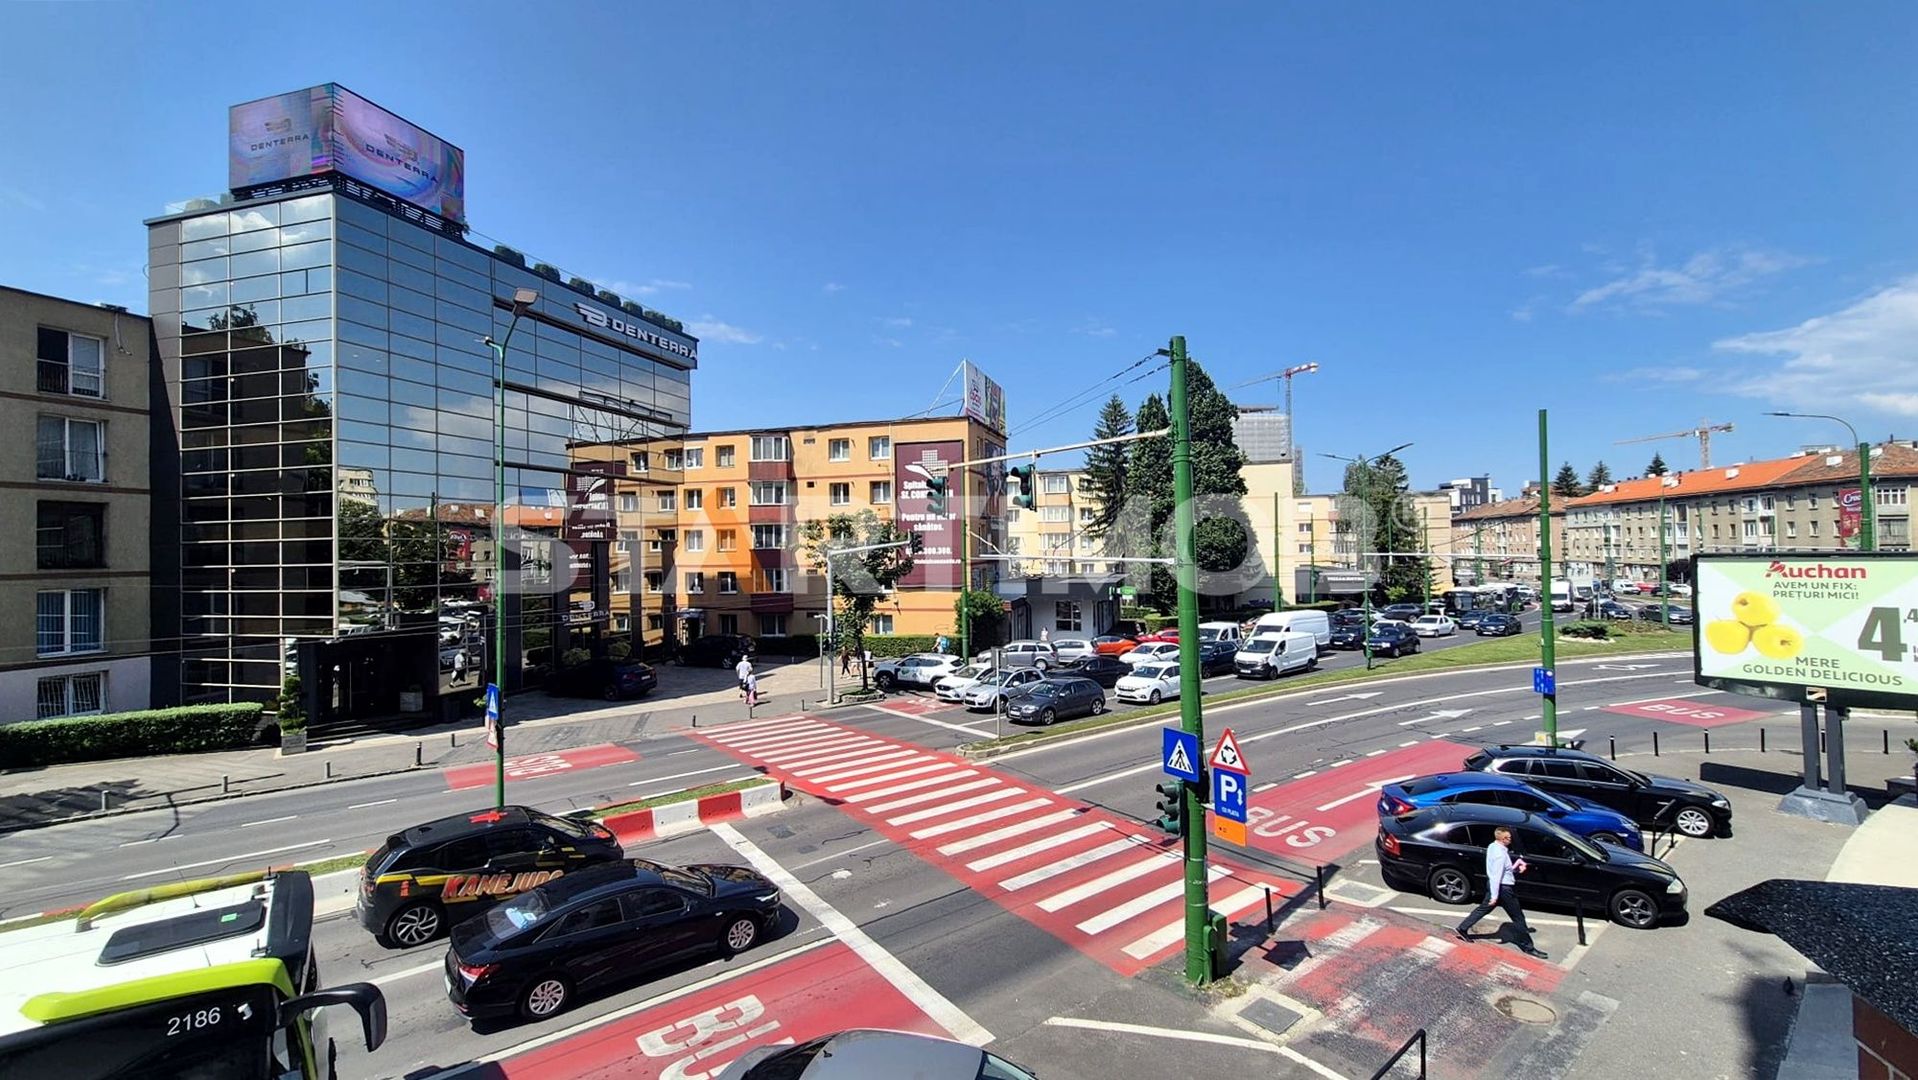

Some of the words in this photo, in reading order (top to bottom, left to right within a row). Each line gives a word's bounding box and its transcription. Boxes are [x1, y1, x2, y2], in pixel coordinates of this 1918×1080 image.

[251, 134, 309, 151] DENTERRA
[365, 143, 438, 182] DENTERRA
[612, 320, 698, 359] DENTERRA
[1765, 561, 1867, 579] Auchan
[1774, 581, 1808, 589] AVEM
[1811, 582, 1830, 590] UN
[1827, 591, 1859, 600] MICI!
[1795, 656, 1840, 669] MERE
[1742, 664, 1807, 678] GOLDEN
[1811, 669, 1903, 686] DELICIOUS
[1639, 704, 1724, 719] BUS
[1220, 774, 1238, 802] P
[167, 1007, 221, 1036] 2186
